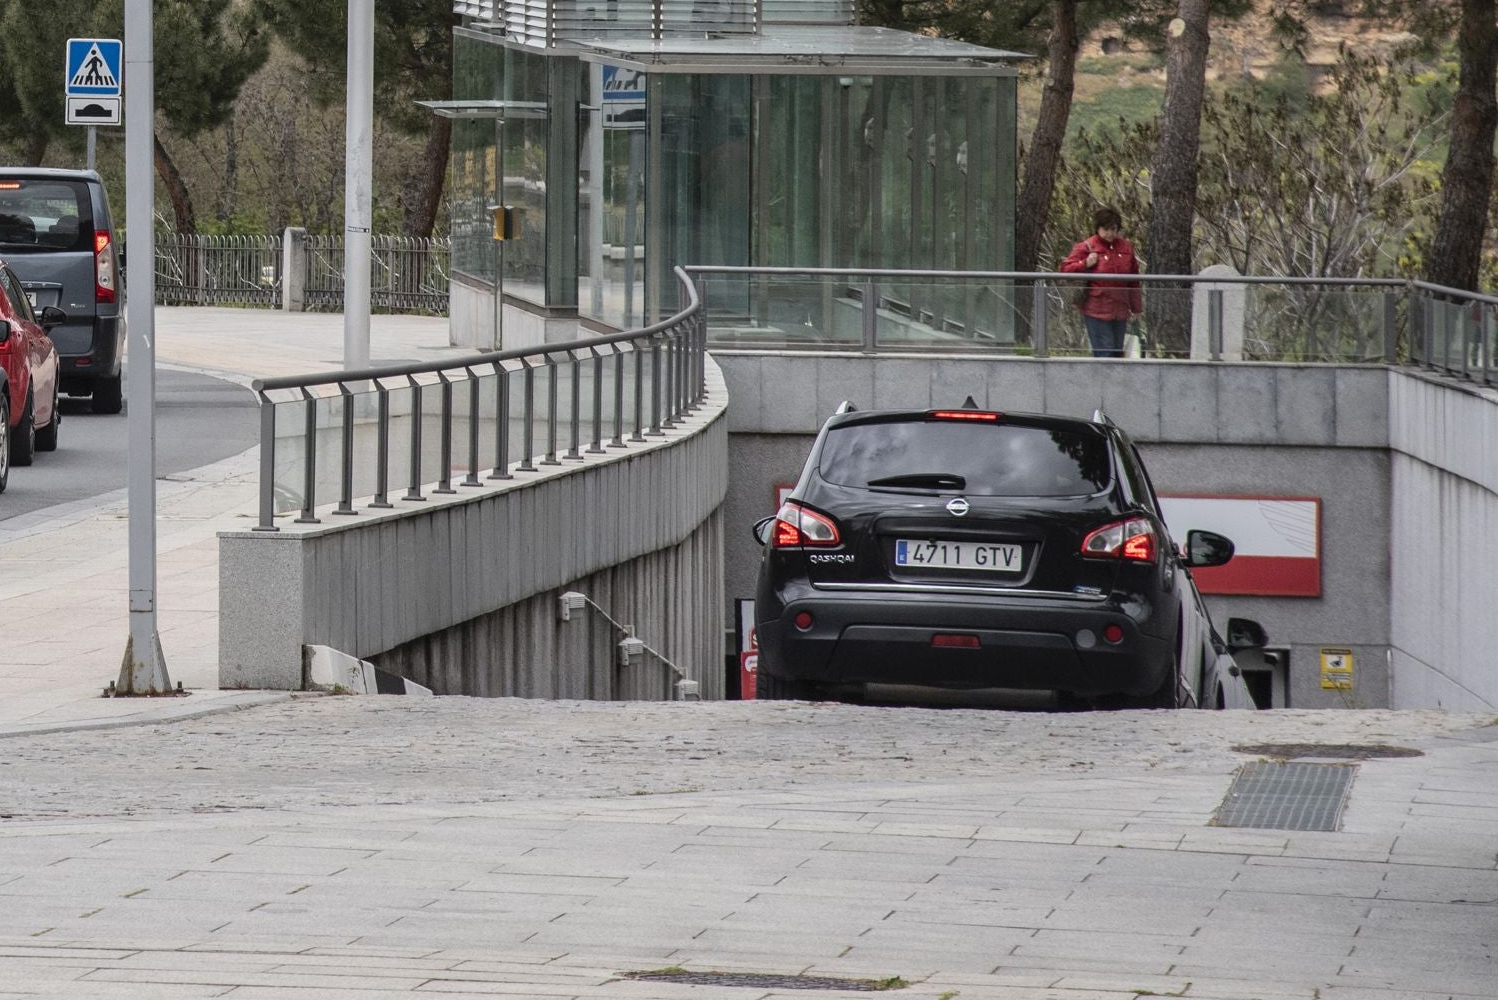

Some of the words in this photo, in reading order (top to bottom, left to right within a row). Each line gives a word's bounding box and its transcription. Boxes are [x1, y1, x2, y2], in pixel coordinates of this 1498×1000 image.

[810, 554, 855, 564] QASHQAI
[913, 544, 960, 565] 4711
[975, 546, 1014, 567] GTV
